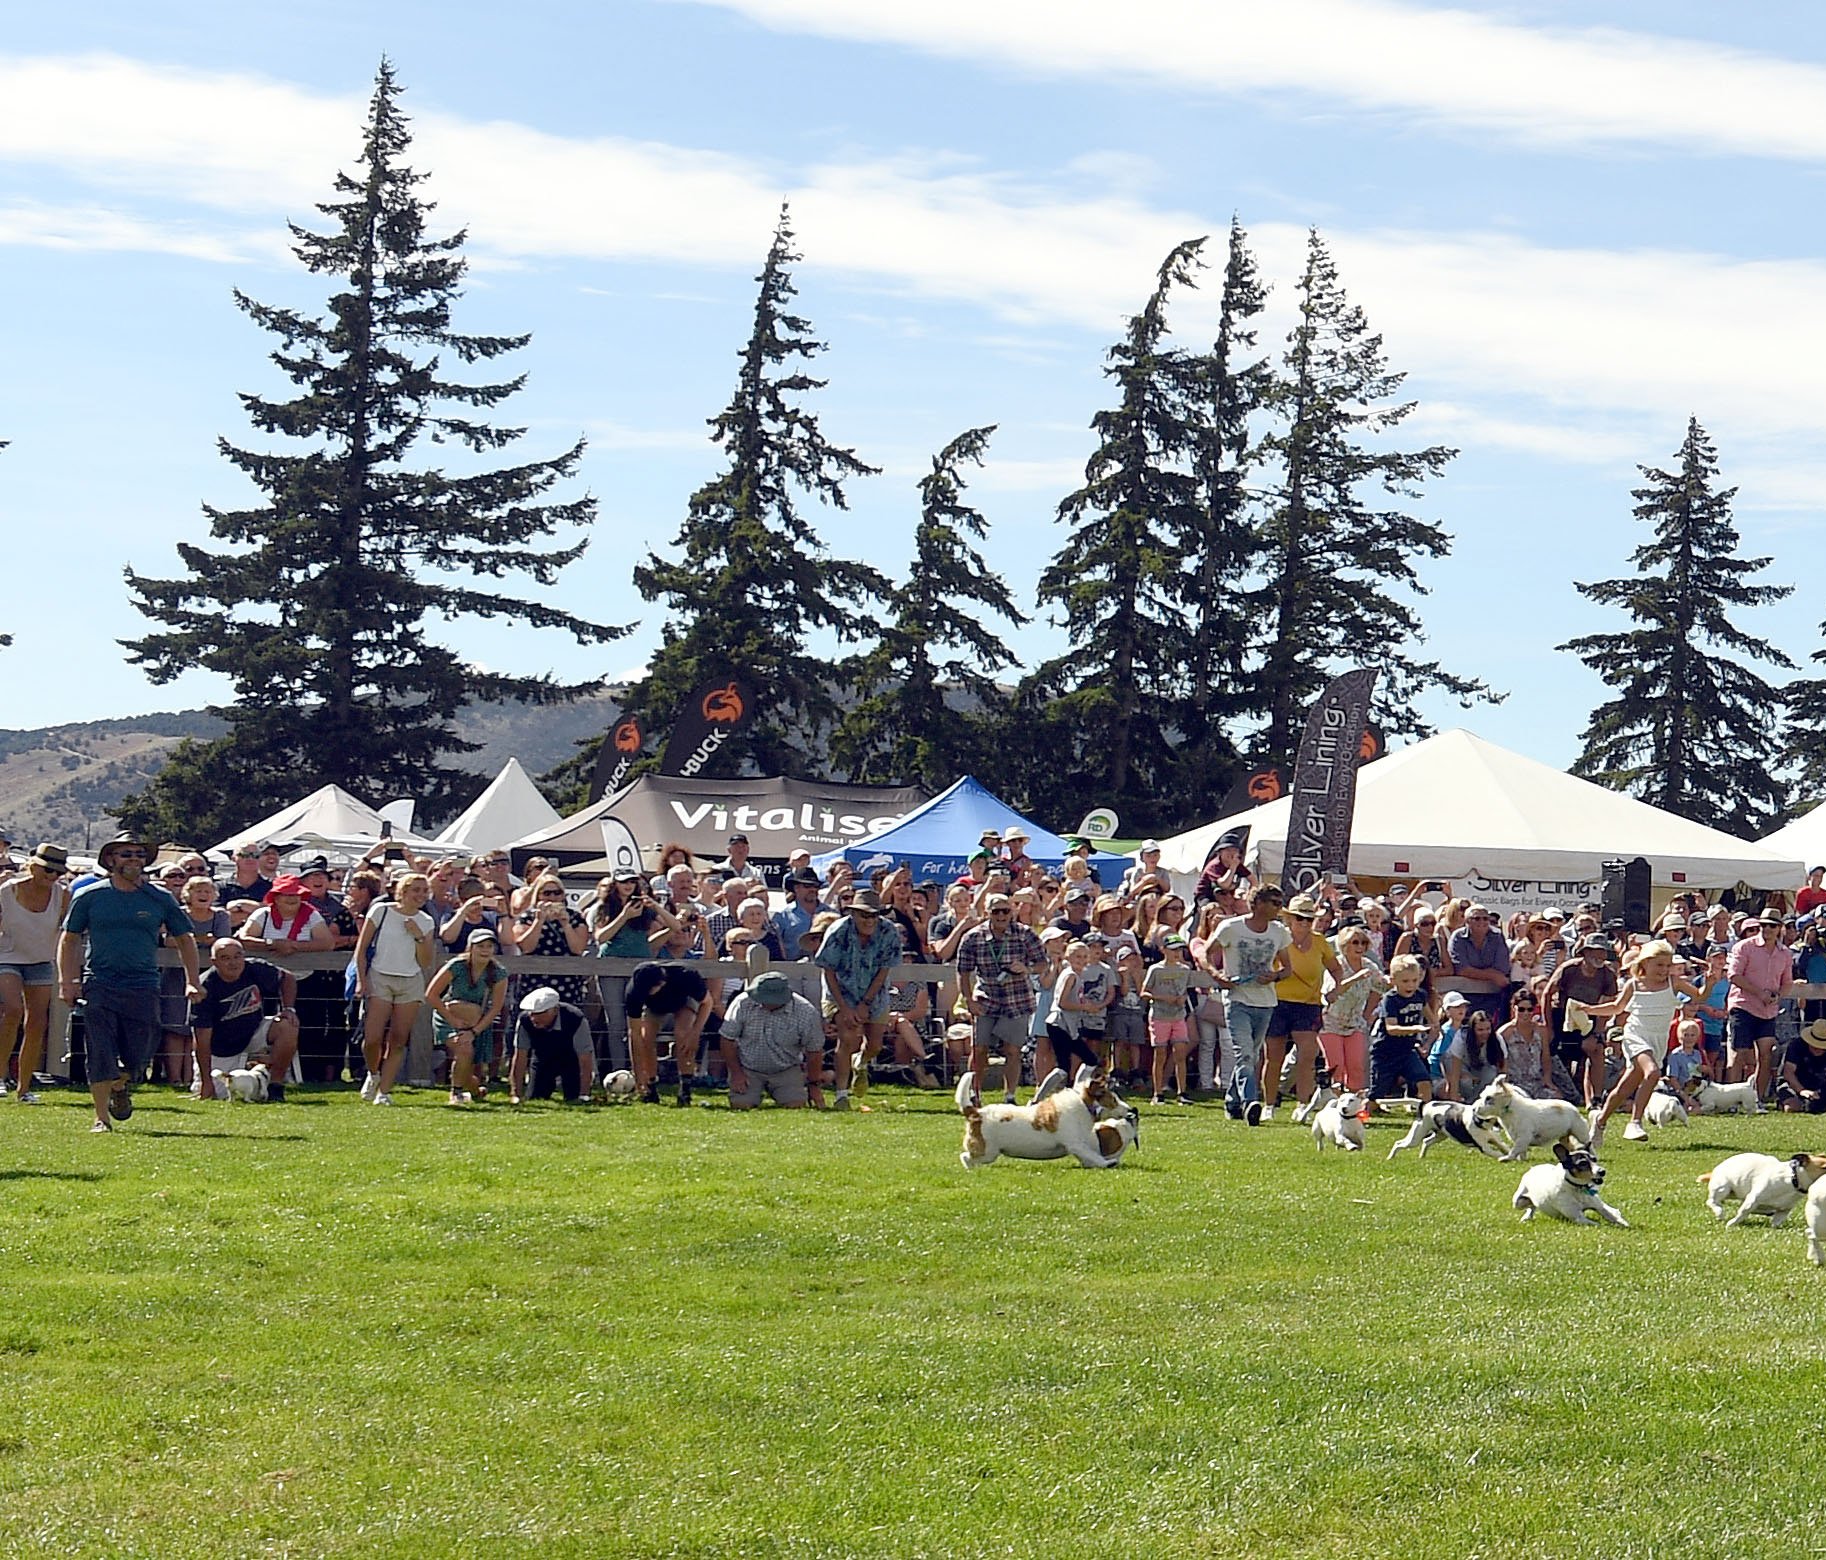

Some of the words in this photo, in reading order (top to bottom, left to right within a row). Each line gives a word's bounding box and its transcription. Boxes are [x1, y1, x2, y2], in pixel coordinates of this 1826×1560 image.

[1341, 702, 1361, 761] Occasion
[1301, 707, 1346, 795] Lining
[1335, 765, 1356, 801] Every
[670, 800, 901, 836] Vitalise
[1333, 804, 1347, 821] for
[798, 834, 844, 845] Animal
[1289, 804, 1325, 891] Silver
[1331, 825, 1348, 853] Bags
